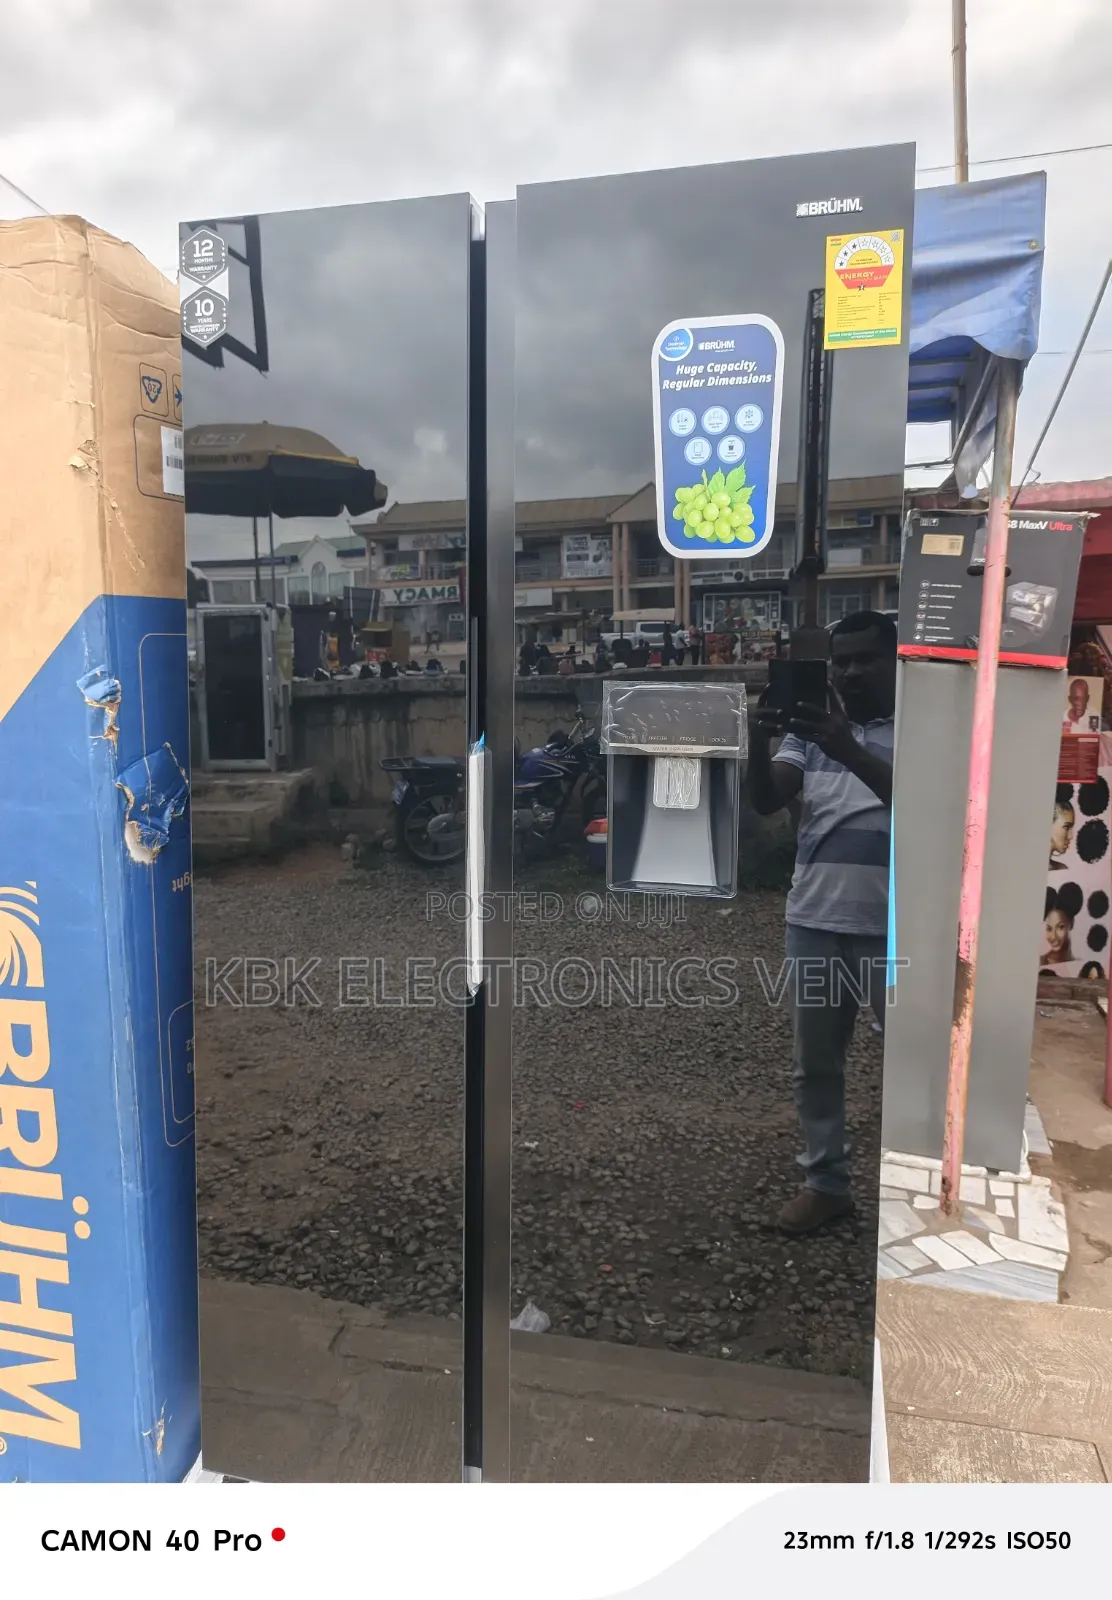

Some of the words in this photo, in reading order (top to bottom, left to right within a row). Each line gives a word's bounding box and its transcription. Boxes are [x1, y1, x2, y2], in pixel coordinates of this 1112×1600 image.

[193, 239, 214, 258] 12
[840, 271, 875, 280] ENERGY
[195, 299, 214, 317] 10
[676, 364, 704, 376] Huge
[706, 360, 758, 374] Capacity,
[662, 378, 705, 391] Regular
[707, 374, 772, 387] Dimensions
[1019, 520, 1048, 530] MaxV
[1048, 522, 1073, 531] Ultra
